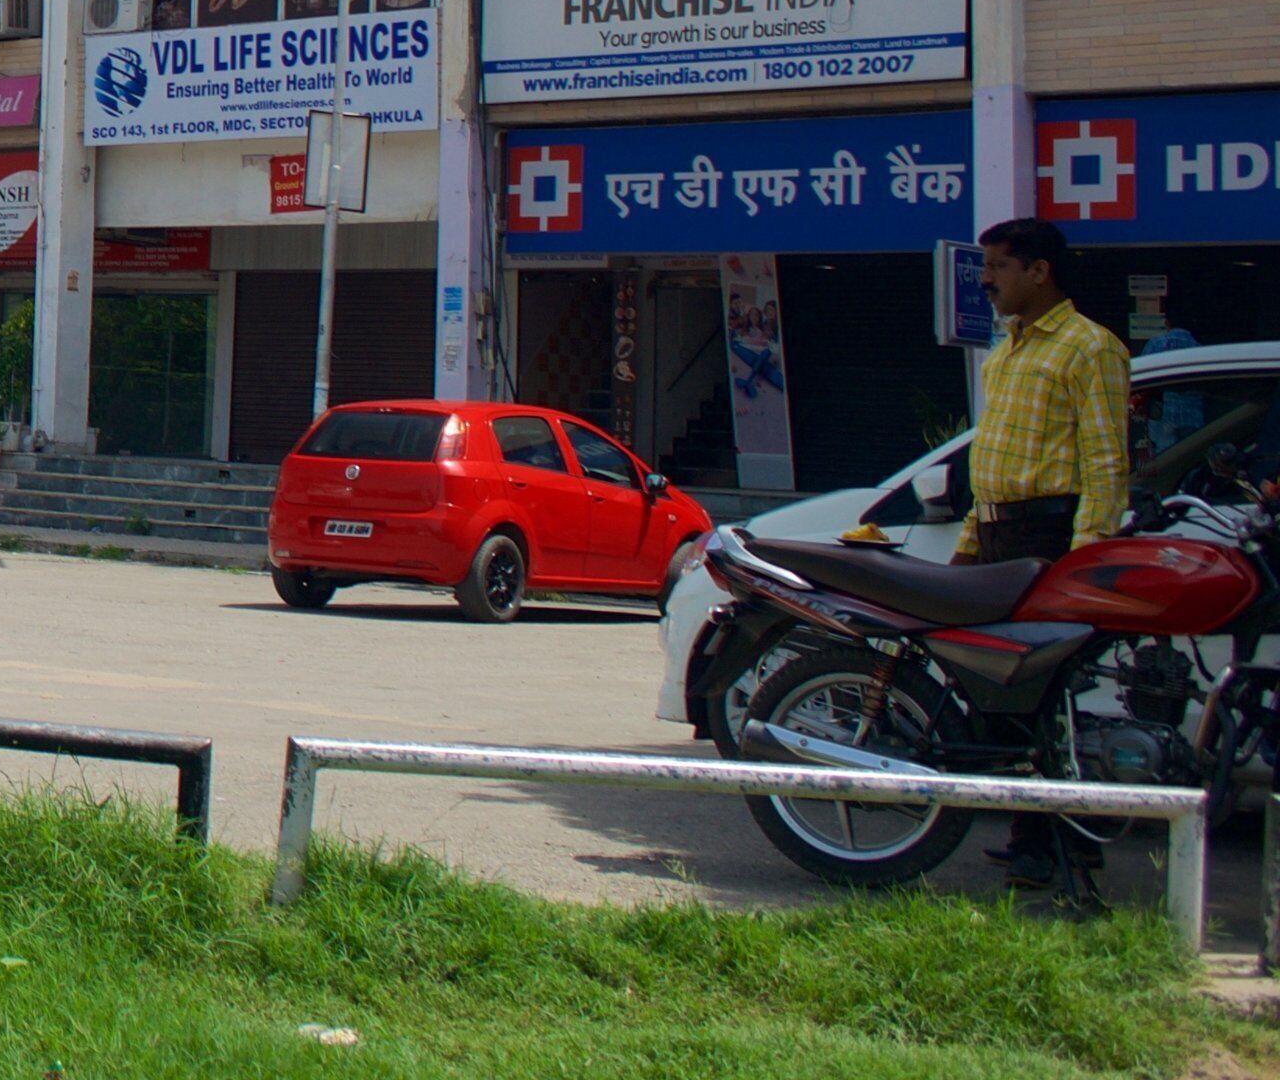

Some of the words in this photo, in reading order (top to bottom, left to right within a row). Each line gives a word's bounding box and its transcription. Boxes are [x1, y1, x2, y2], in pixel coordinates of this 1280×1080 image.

[599, 31, 637, 48] Your
[640, 24, 700, 49] growth
[704, 24, 716, 41] is
[720, 25, 748, 40] our
[753, 18, 826, 38] business
[152, 38, 204, 75] VDL
[213, 32, 272, 72] LIFE
[166, 80, 229, 100] Ensuring
[234, 77, 280, 96] Better
[286, 73, 336, 92] Health
[366, 66, 413, 87] World
[523, 66, 747, 92] www.franchiseindia.com
[763, 61, 812, 80] 1800
[817, 59, 852, 77] 102
[858, 55, 915, 74] 2007
[92, 126, 117, 139] SCO
[121, 125, 147, 139] 143,
[150, 122, 169, 135] 1st
[173, 120, 218, 135] FLOOR,
[222, 117, 255, 133] MDC,
[885, 144, 966, 205] बैंक
[1166, 141, 1280, 193] HD
